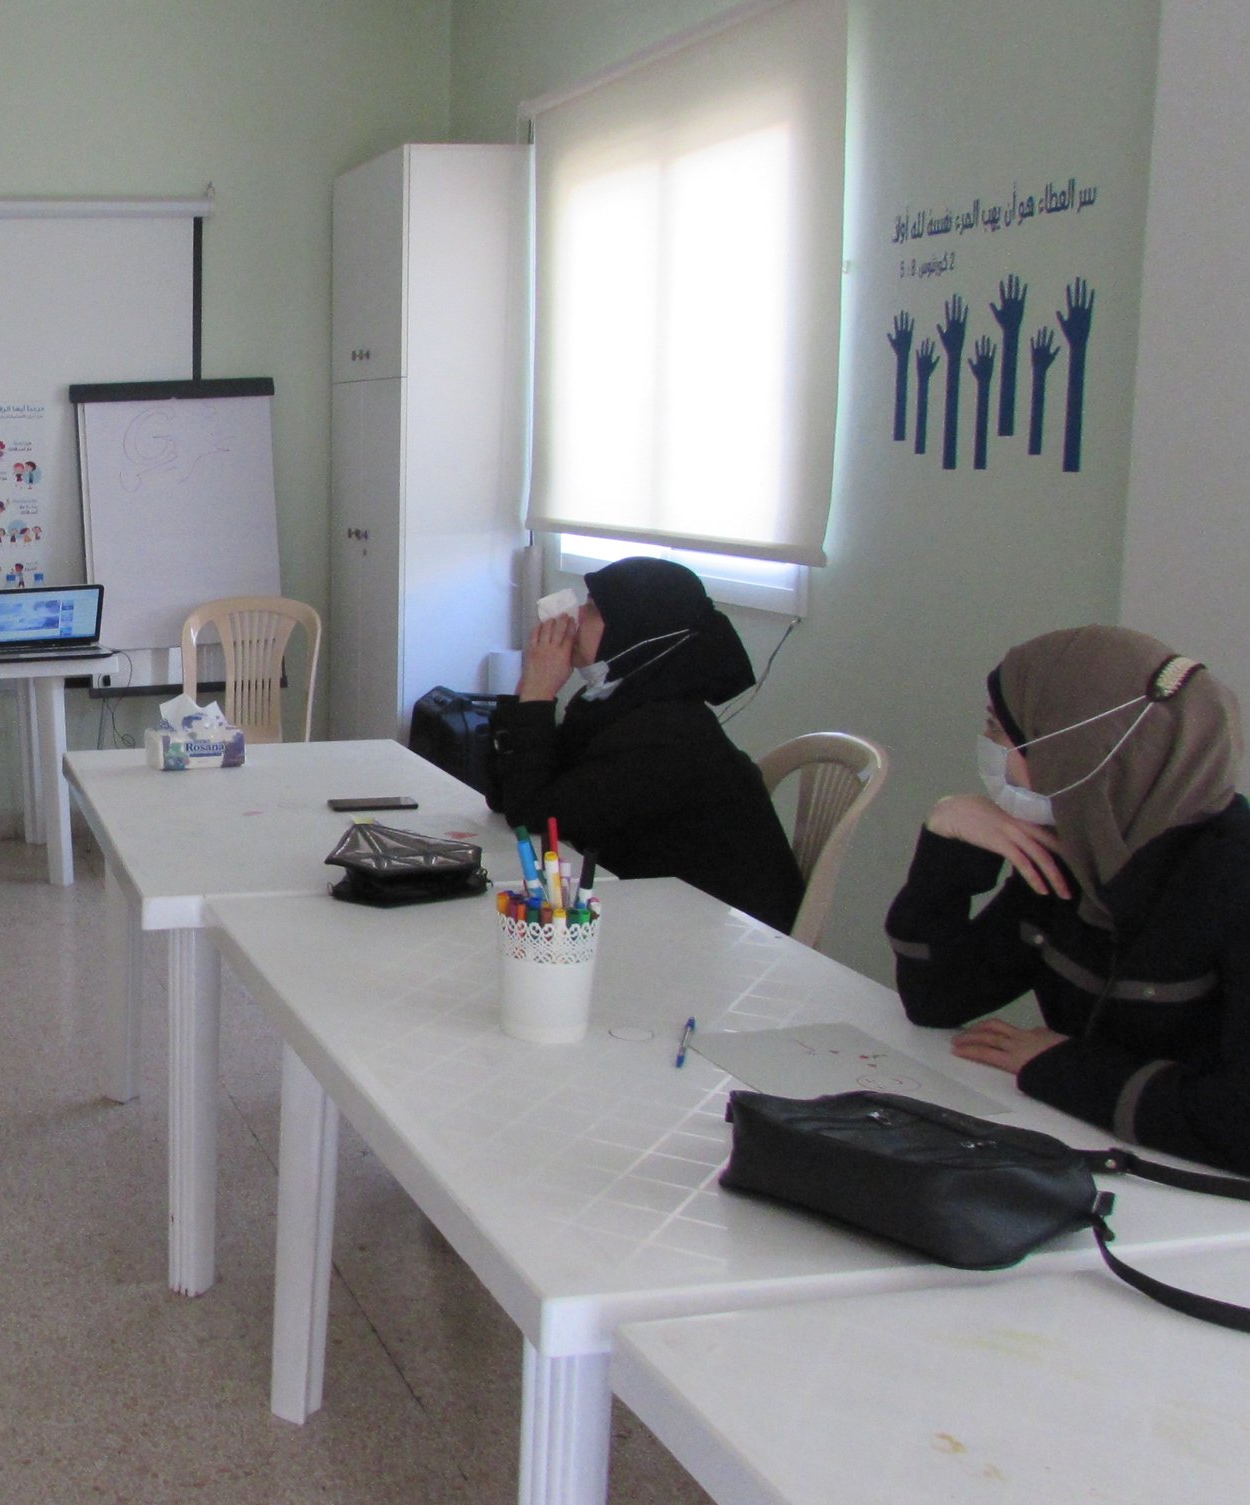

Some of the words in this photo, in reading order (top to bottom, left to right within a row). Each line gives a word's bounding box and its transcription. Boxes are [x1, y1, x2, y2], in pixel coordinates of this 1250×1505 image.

[1017, 196, 1035, 226] هو
[1038, 178, 1075, 214] العطاء
[1076, 187, 1097, 214] سر
[911, 209, 926, 239] لله
[955, 199, 980, 235] المرء
[981, 206, 1000, 232] يهب
